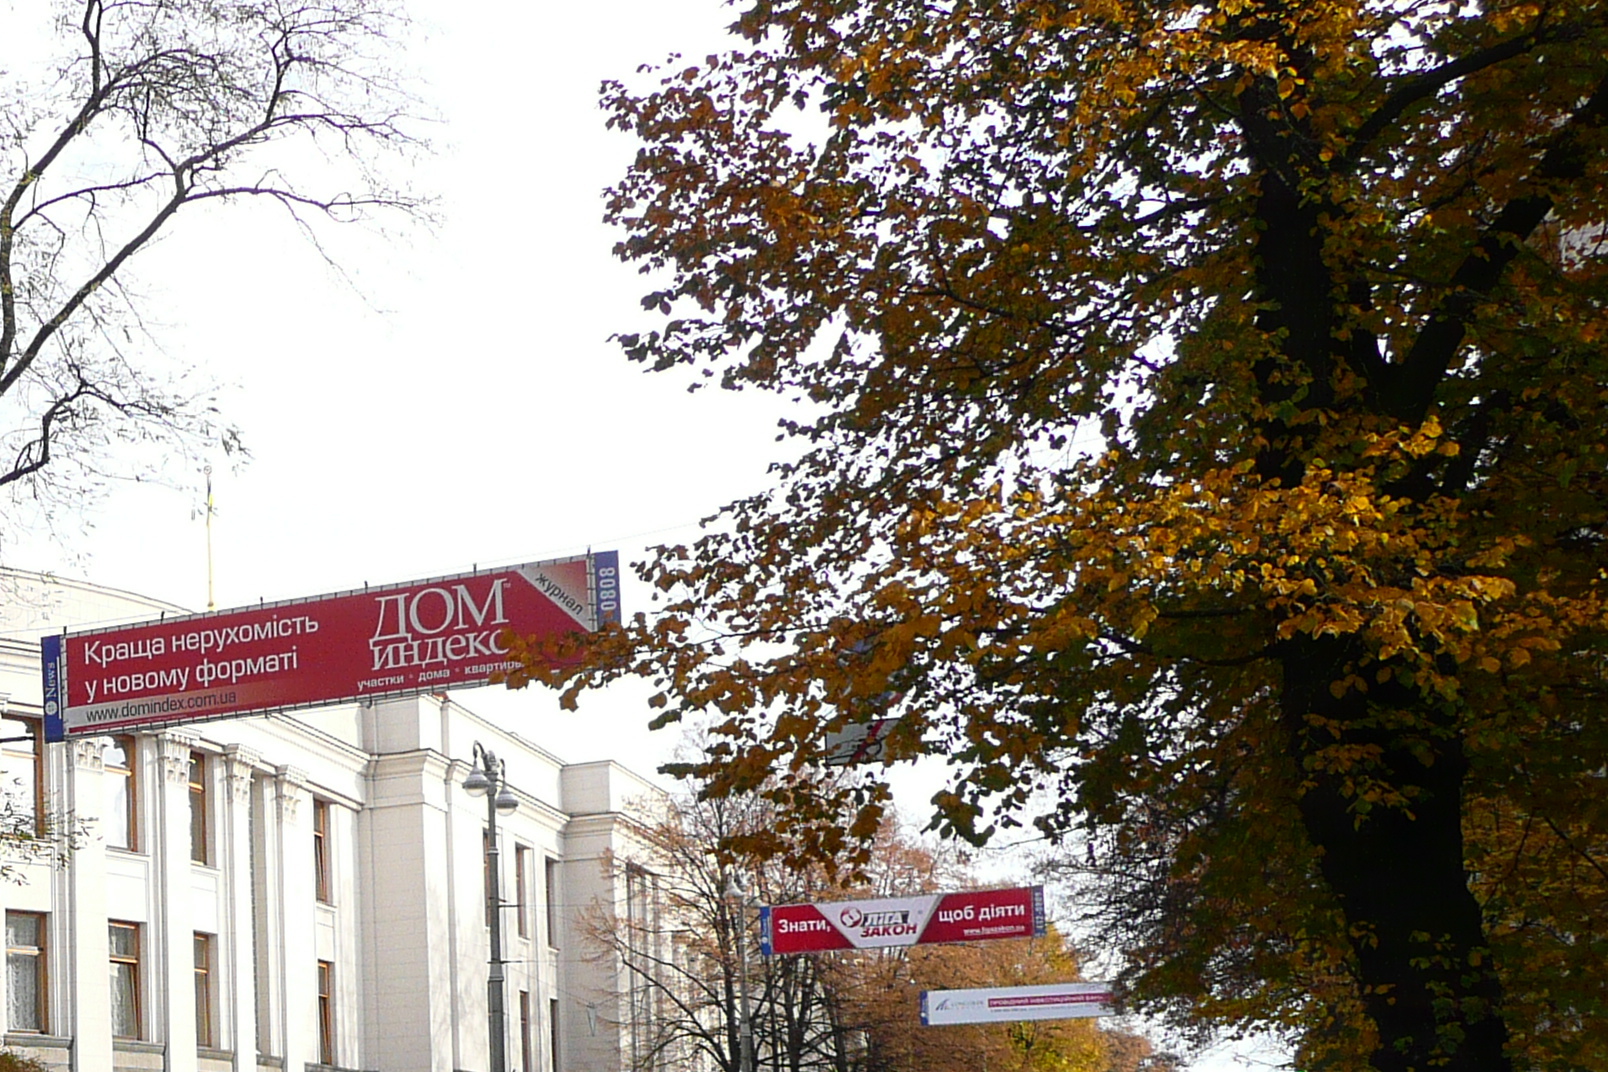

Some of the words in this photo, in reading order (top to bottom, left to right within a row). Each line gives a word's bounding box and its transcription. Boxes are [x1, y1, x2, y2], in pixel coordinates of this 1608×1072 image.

[535, 573, 584, 615] журнал
[599, 567, 616, 611] 0808
[369, 578, 510, 650] ДОМ
[84, 637, 165, 668] Краща
[172, 614, 319, 654] нерухомість
[371, 629, 510, 671] индекс
[45, 662, 57, 699] News
[85, 679, 97, 703] у
[103, 667, 189, 695] новому
[195, 645, 298, 687] форматі
[357, 674, 404, 691] участки
[418, 669, 450, 683] дома
[86, 691, 237, 722] www.domindex.com.ua
[778, 918, 831, 933] Знати,
[860, 924, 918, 938] ЗАКОН
[938, 905, 975, 924] щоб
[978, 904, 1025, 921] діяти
